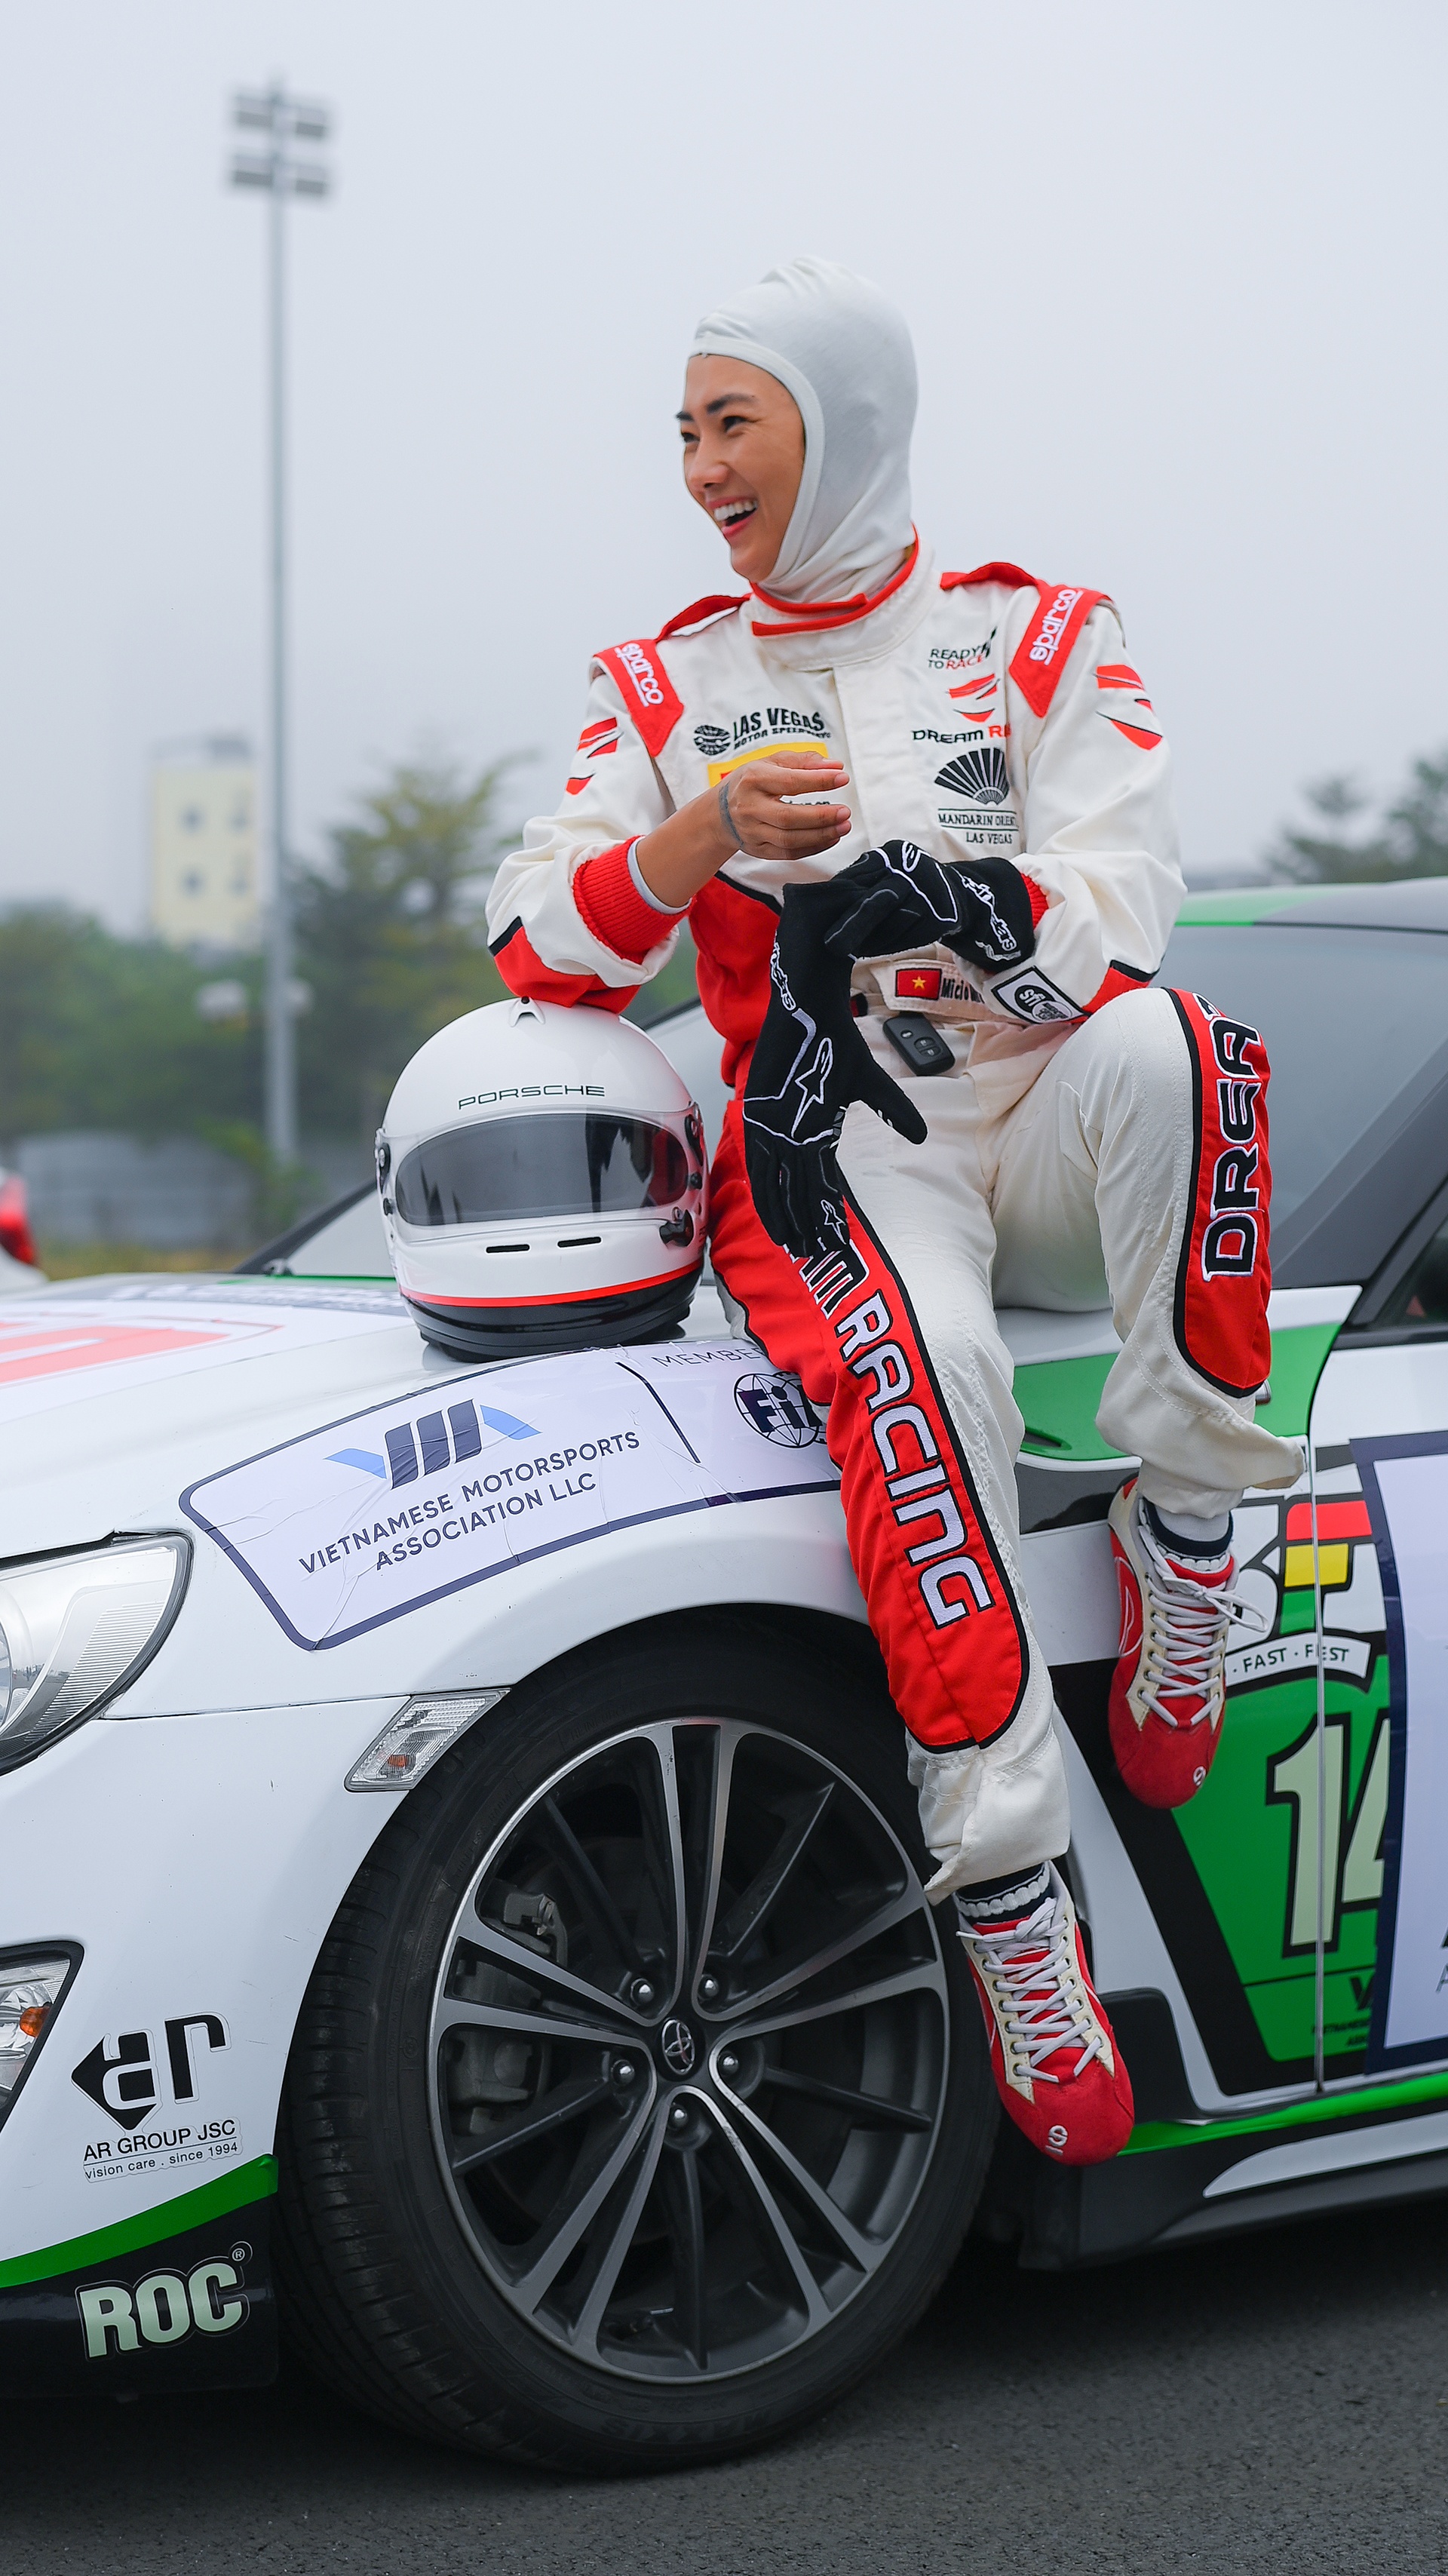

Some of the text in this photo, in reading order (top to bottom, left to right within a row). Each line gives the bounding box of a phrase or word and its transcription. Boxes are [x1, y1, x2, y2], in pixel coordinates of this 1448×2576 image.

[1029, 589, 1078, 662] sparco
[928, 655, 983, 669] TO RACE
[931, 646, 980, 660] READY
[615, 643, 664, 705] sparco
[733, 708, 824, 741] LAS VEGAS
[912, 729, 983, 744] DREAM
[938, 814, 1017, 827] MANDARIN ORIEN
[966, 832, 1013, 844] LAS VEGAS
[459, 1084, 606, 1110] PORSCHE
[1199, 992, 1262, 1282] DREA
[836, 1291, 996, 1631] RACING
[299, 1431, 640, 1574] VIETNAMESE MOTORSPORTS
[376, 1472, 597, 1571] ASSOCIATION LLC
[1243, 1644, 1350, 1673] FAST FEST
[84, 2119, 235, 2162] AR GROUP JSC
[85, 2142, 238, 2178] vision care since 1994
